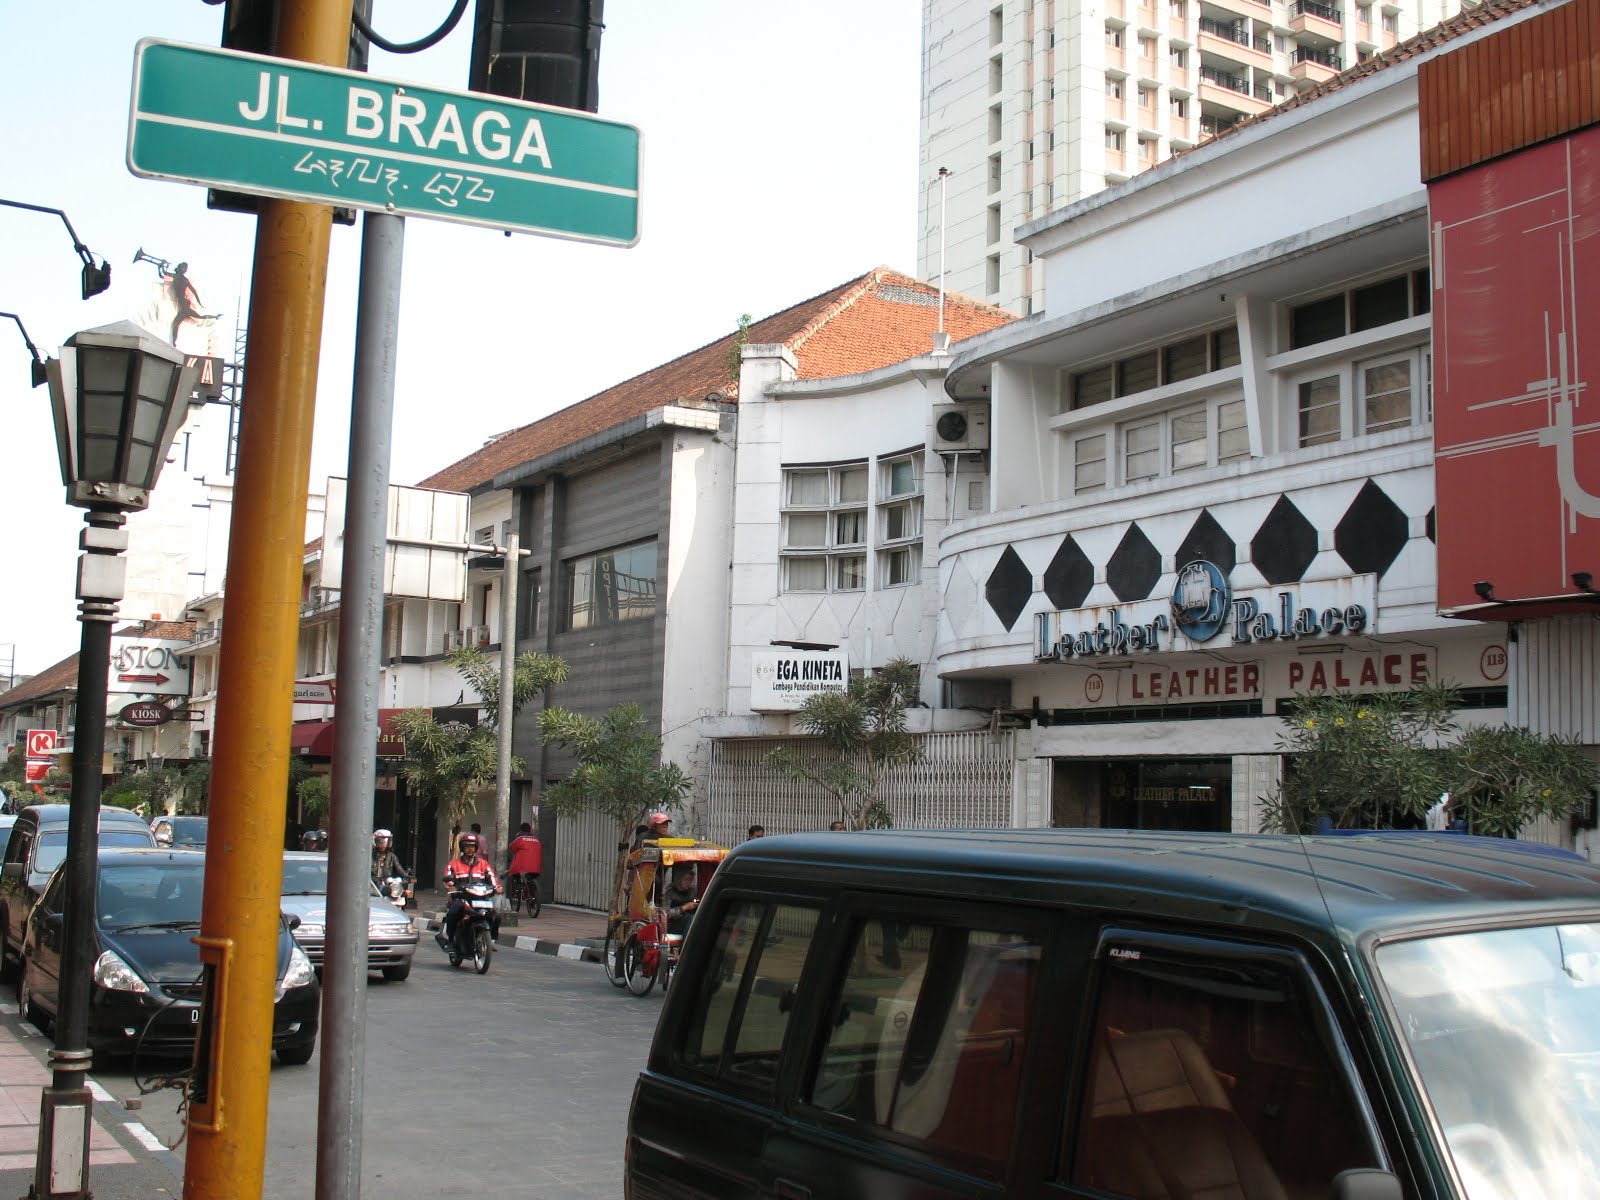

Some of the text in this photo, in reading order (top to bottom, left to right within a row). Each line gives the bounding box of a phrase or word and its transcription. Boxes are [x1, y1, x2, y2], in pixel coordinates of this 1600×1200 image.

[239, 72, 553, 169] JL. BRAGA
[1034, 592, 1367, 660] Leather Palace
[777, 660, 799, 680] EGA
[802, 660, 842, 680] KINETA
[1132, 653, 1427, 699] LEATHER PALACE
[773, 682, 793, 692] Lembaga
[132, 710, 160, 719] KIOSK
